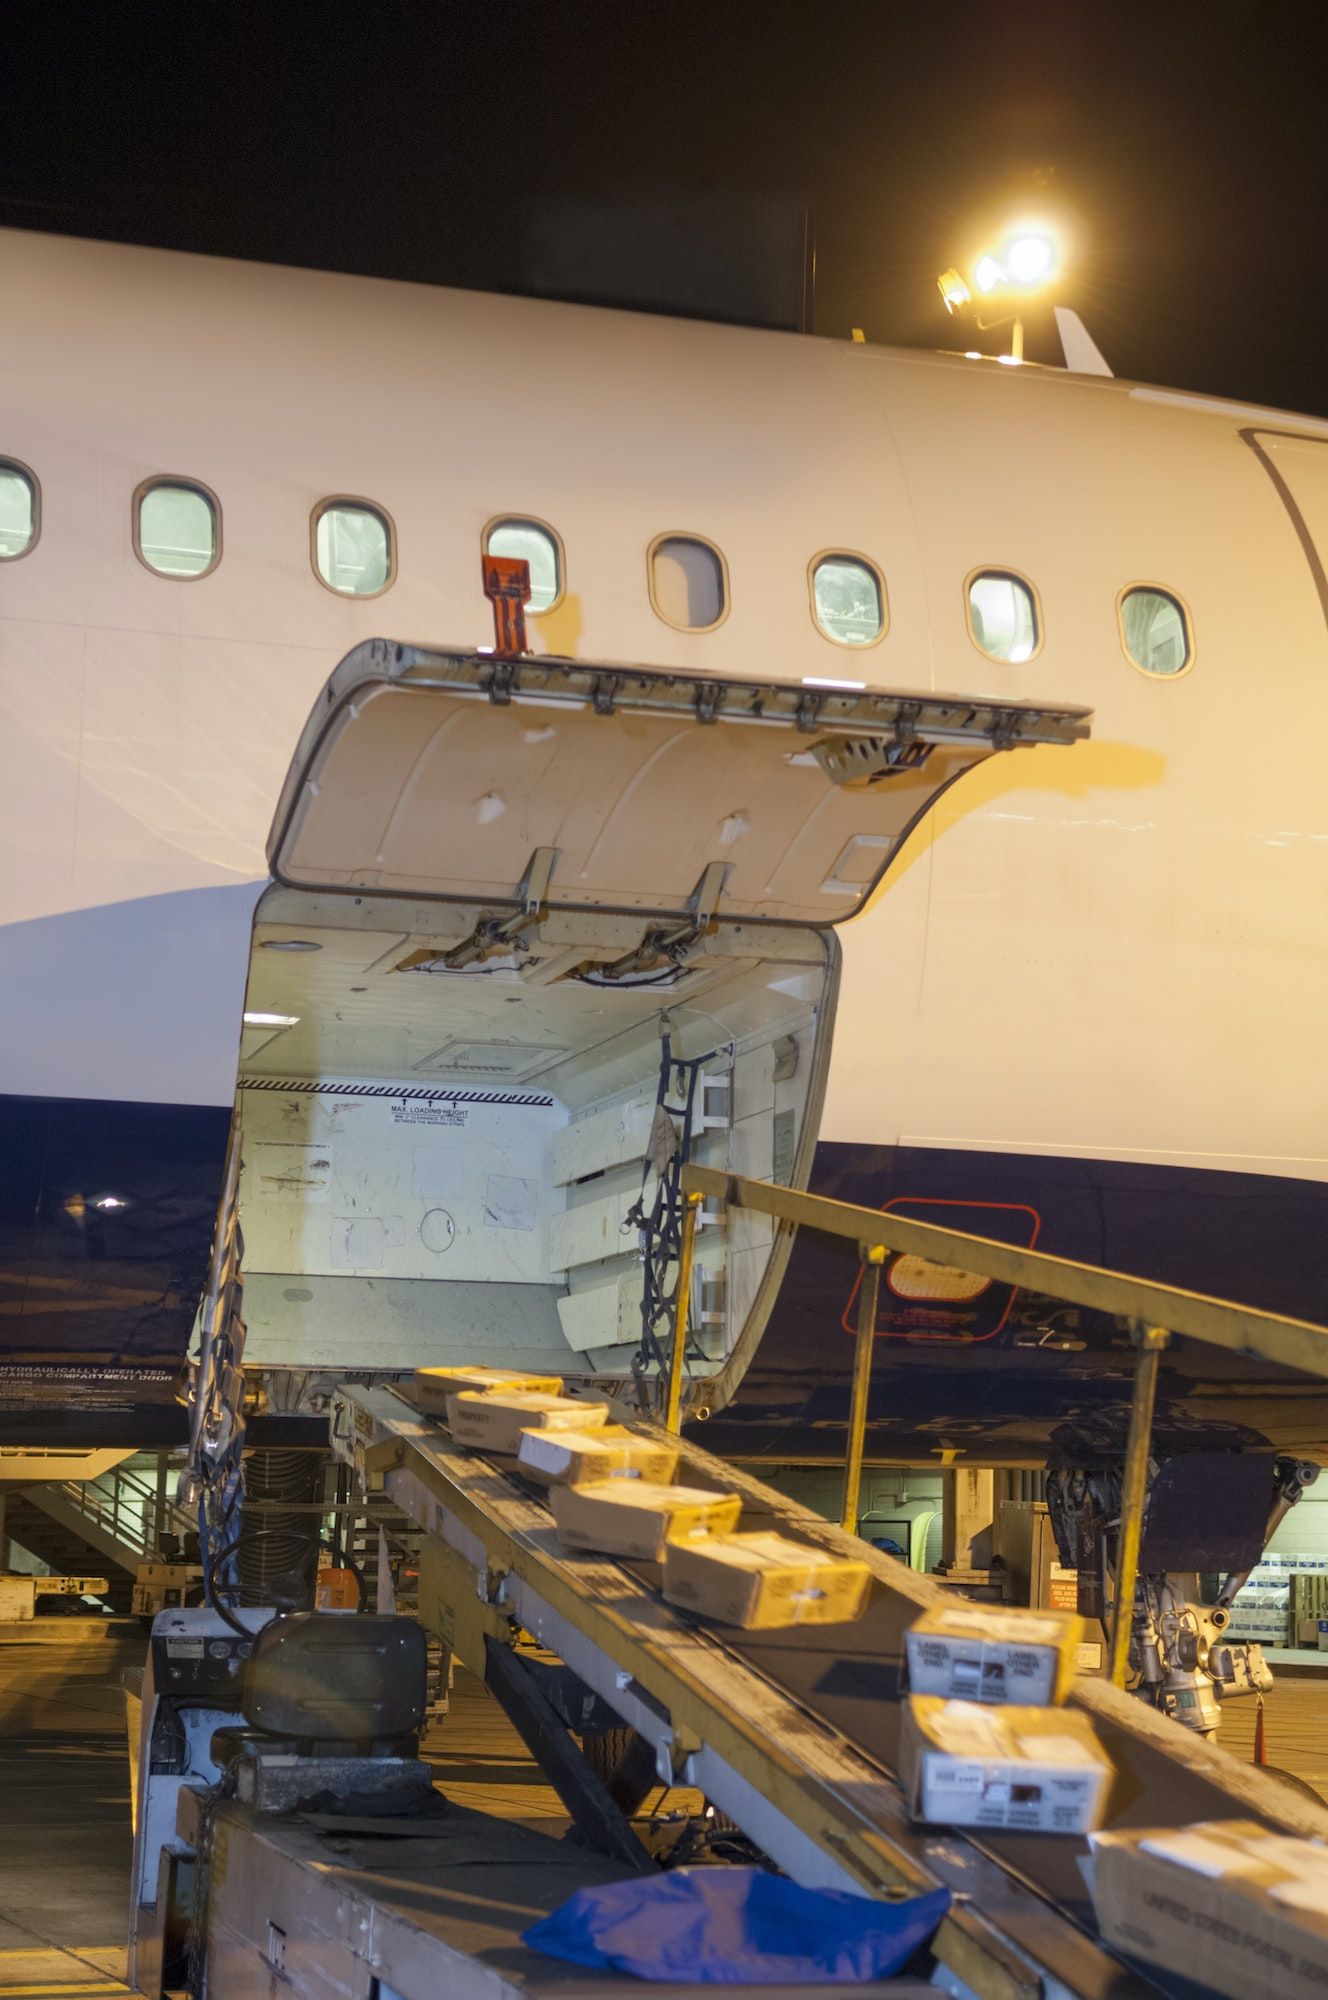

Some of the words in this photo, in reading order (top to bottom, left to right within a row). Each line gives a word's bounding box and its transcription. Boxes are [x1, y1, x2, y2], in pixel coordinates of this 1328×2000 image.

[410, 1107, 441, 1115] LOADING
[0, 1366, 100, 1374] HYDRAULICALLY
[103, 1368, 166, 1376] OPERATED
[46, 1372, 136, 1381] COMPARTMENT
[458, 1411, 489, 1422] PROPERTY
[917, 1641, 947, 1651] LABEL
[917, 1649, 949, 1659] OTHER
[1007, 1651, 1038, 1661] LABEL
[924, 1658, 943, 1667] END
[1007, 1659, 1040, 1669] OTHER
[1013, 1668, 1034, 1677] END
[1143, 1891, 1191, 1923] UNITED
[1193, 1912, 1240, 1945] STATES
[1242, 1933, 1294, 1970] POSTAL
